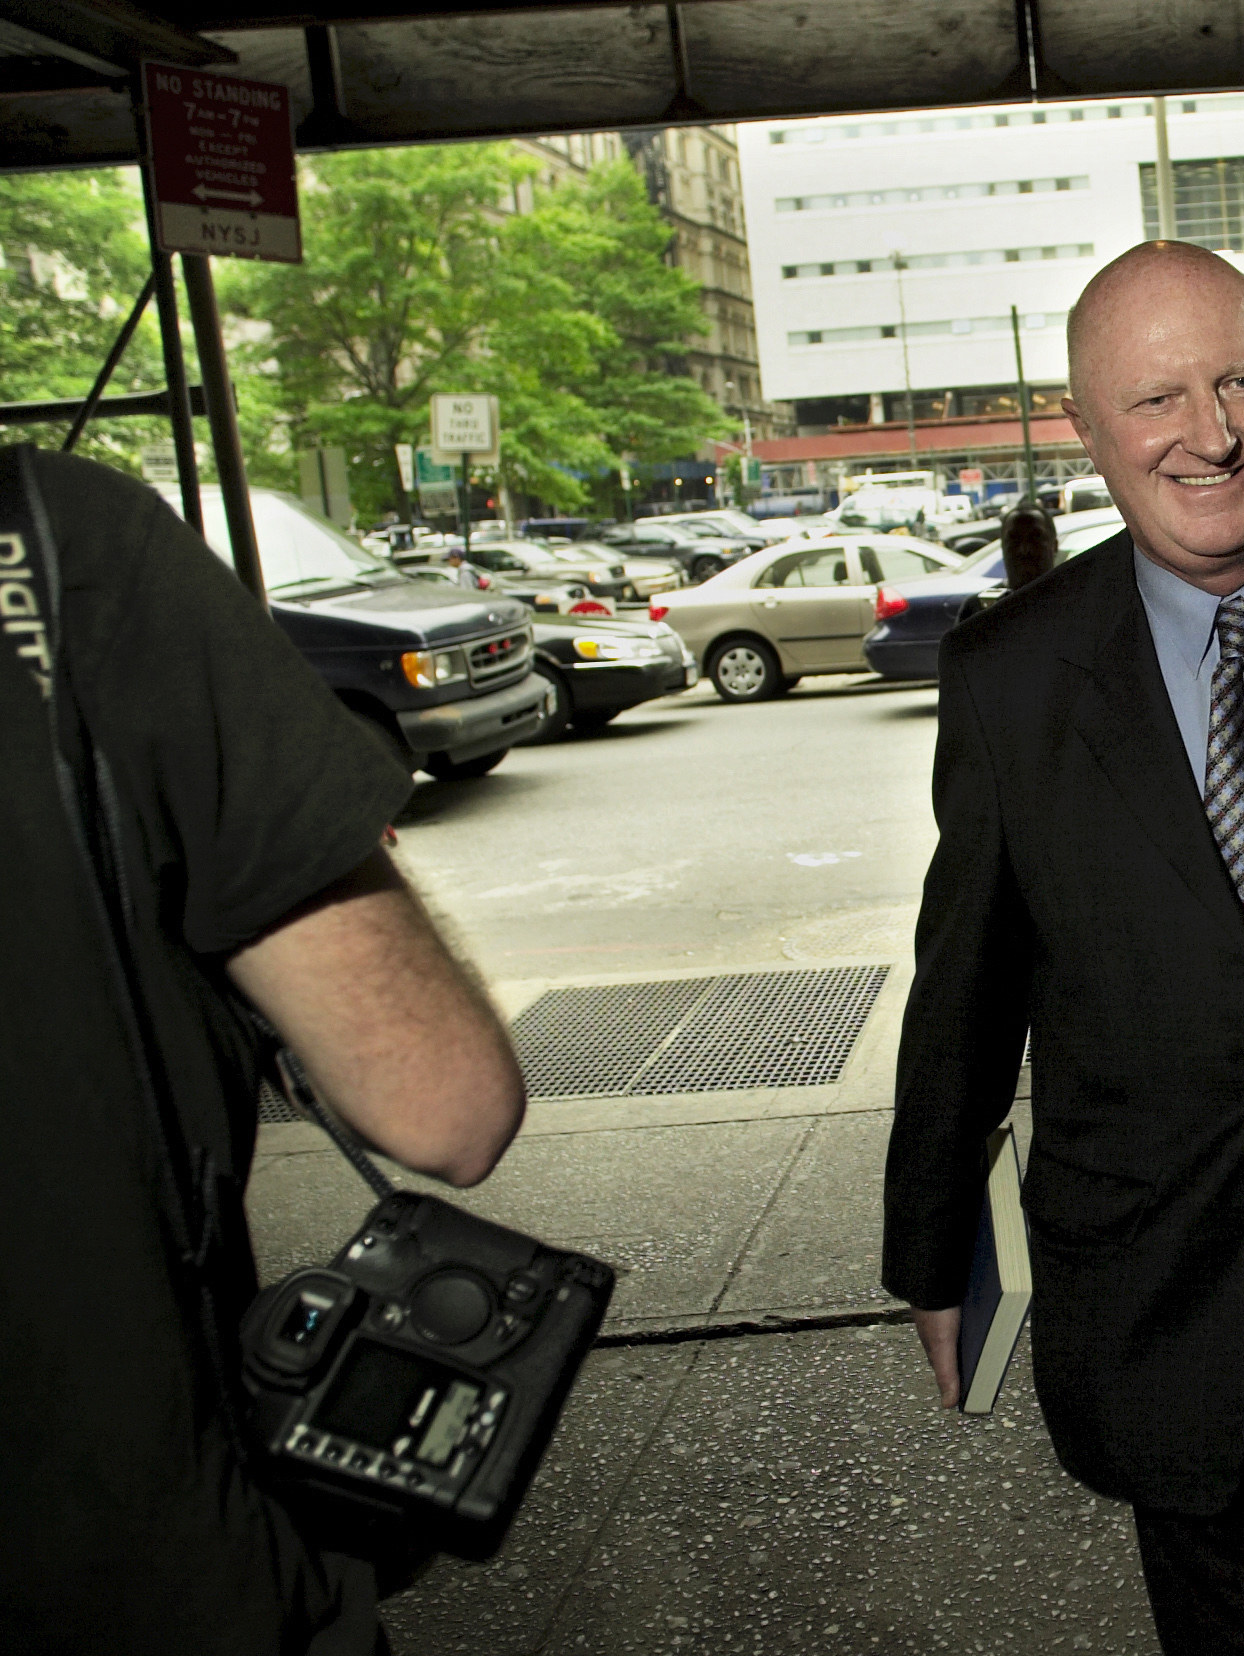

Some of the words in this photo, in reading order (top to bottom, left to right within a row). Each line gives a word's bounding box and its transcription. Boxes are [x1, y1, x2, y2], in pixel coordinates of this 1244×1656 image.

[155, 72, 183, 95] NO
[192, 78, 282, 112] STANDING
[453, 401, 473, 415] NO
[450, 418, 479, 430] THRU
[443, 432, 486, 444] TRAFFIC
